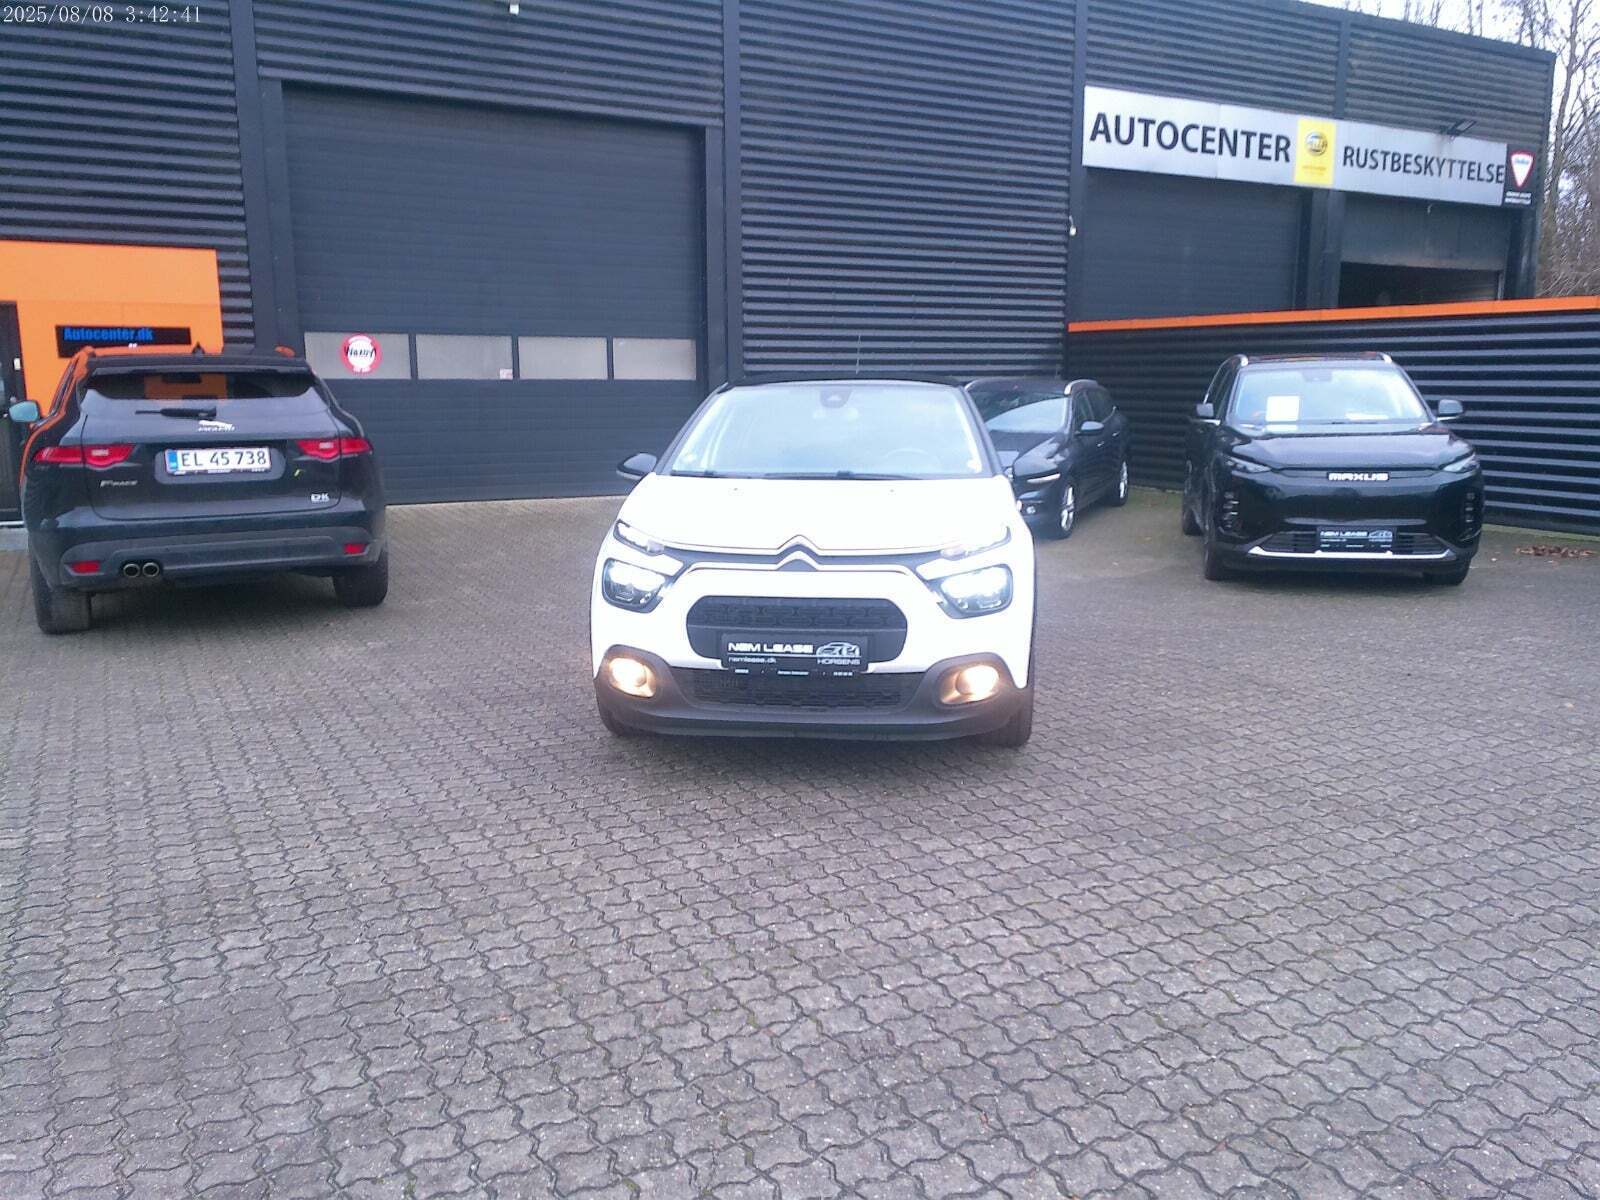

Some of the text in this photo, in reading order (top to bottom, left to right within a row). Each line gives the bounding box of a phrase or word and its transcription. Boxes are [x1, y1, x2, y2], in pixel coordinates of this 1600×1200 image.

[1090, 112, 1291, 163] AUTOCENTER
[1343, 145, 1506, 184] RUSTBESKYTTELSE
[181, 450, 267, 467] EL 45 738
[1328, 472, 1389, 481] MAXUS
[728, 642, 814, 654] NEM LEASE
[816, 658, 861, 666] HORSENS
